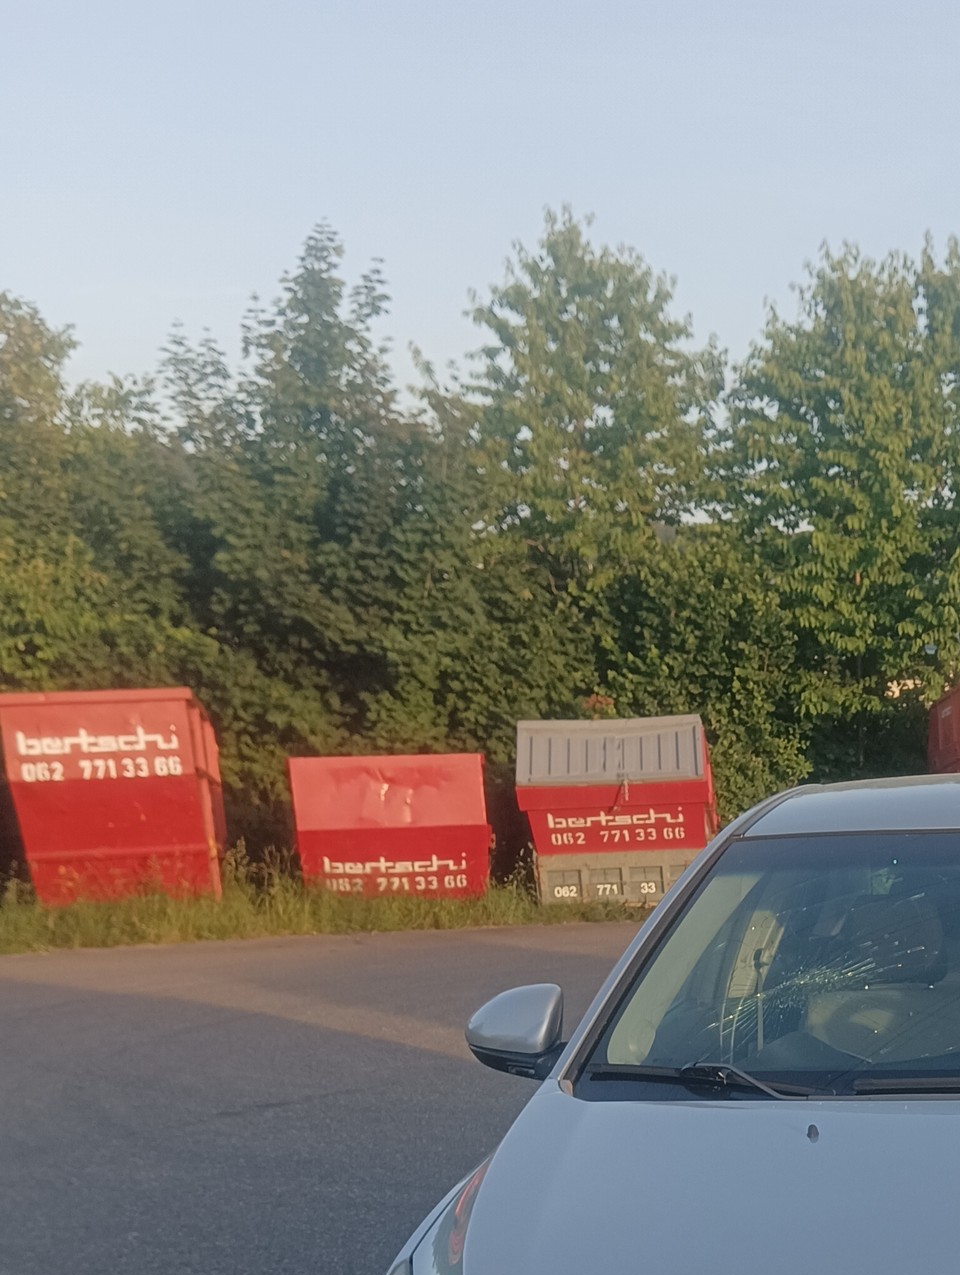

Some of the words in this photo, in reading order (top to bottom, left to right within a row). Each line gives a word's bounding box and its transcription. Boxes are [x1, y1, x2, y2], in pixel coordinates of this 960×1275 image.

[16, 724, 179, 755] bertschi
[21, 761, 64, 782] 062
[79, 758, 118, 780] 771
[121, 757, 150, 778] 33
[154, 755, 183, 776] 66
[547, 807, 684, 829] bertschi
[551, 832, 586, 845] 062
[600, 829, 630, 843] 771
[635, 828, 657, 841] 33
[663, 827, 685, 840] 66
[323, 852, 466, 874] bertschi
[376, 877, 410, 891] 771
[415, 875, 438, 890] 33
[444, 874, 467, 888] 66
[554, 885, 577, 897] 062
[597, 884, 618, 896] 771
[640, 882, 656, 894] 33
